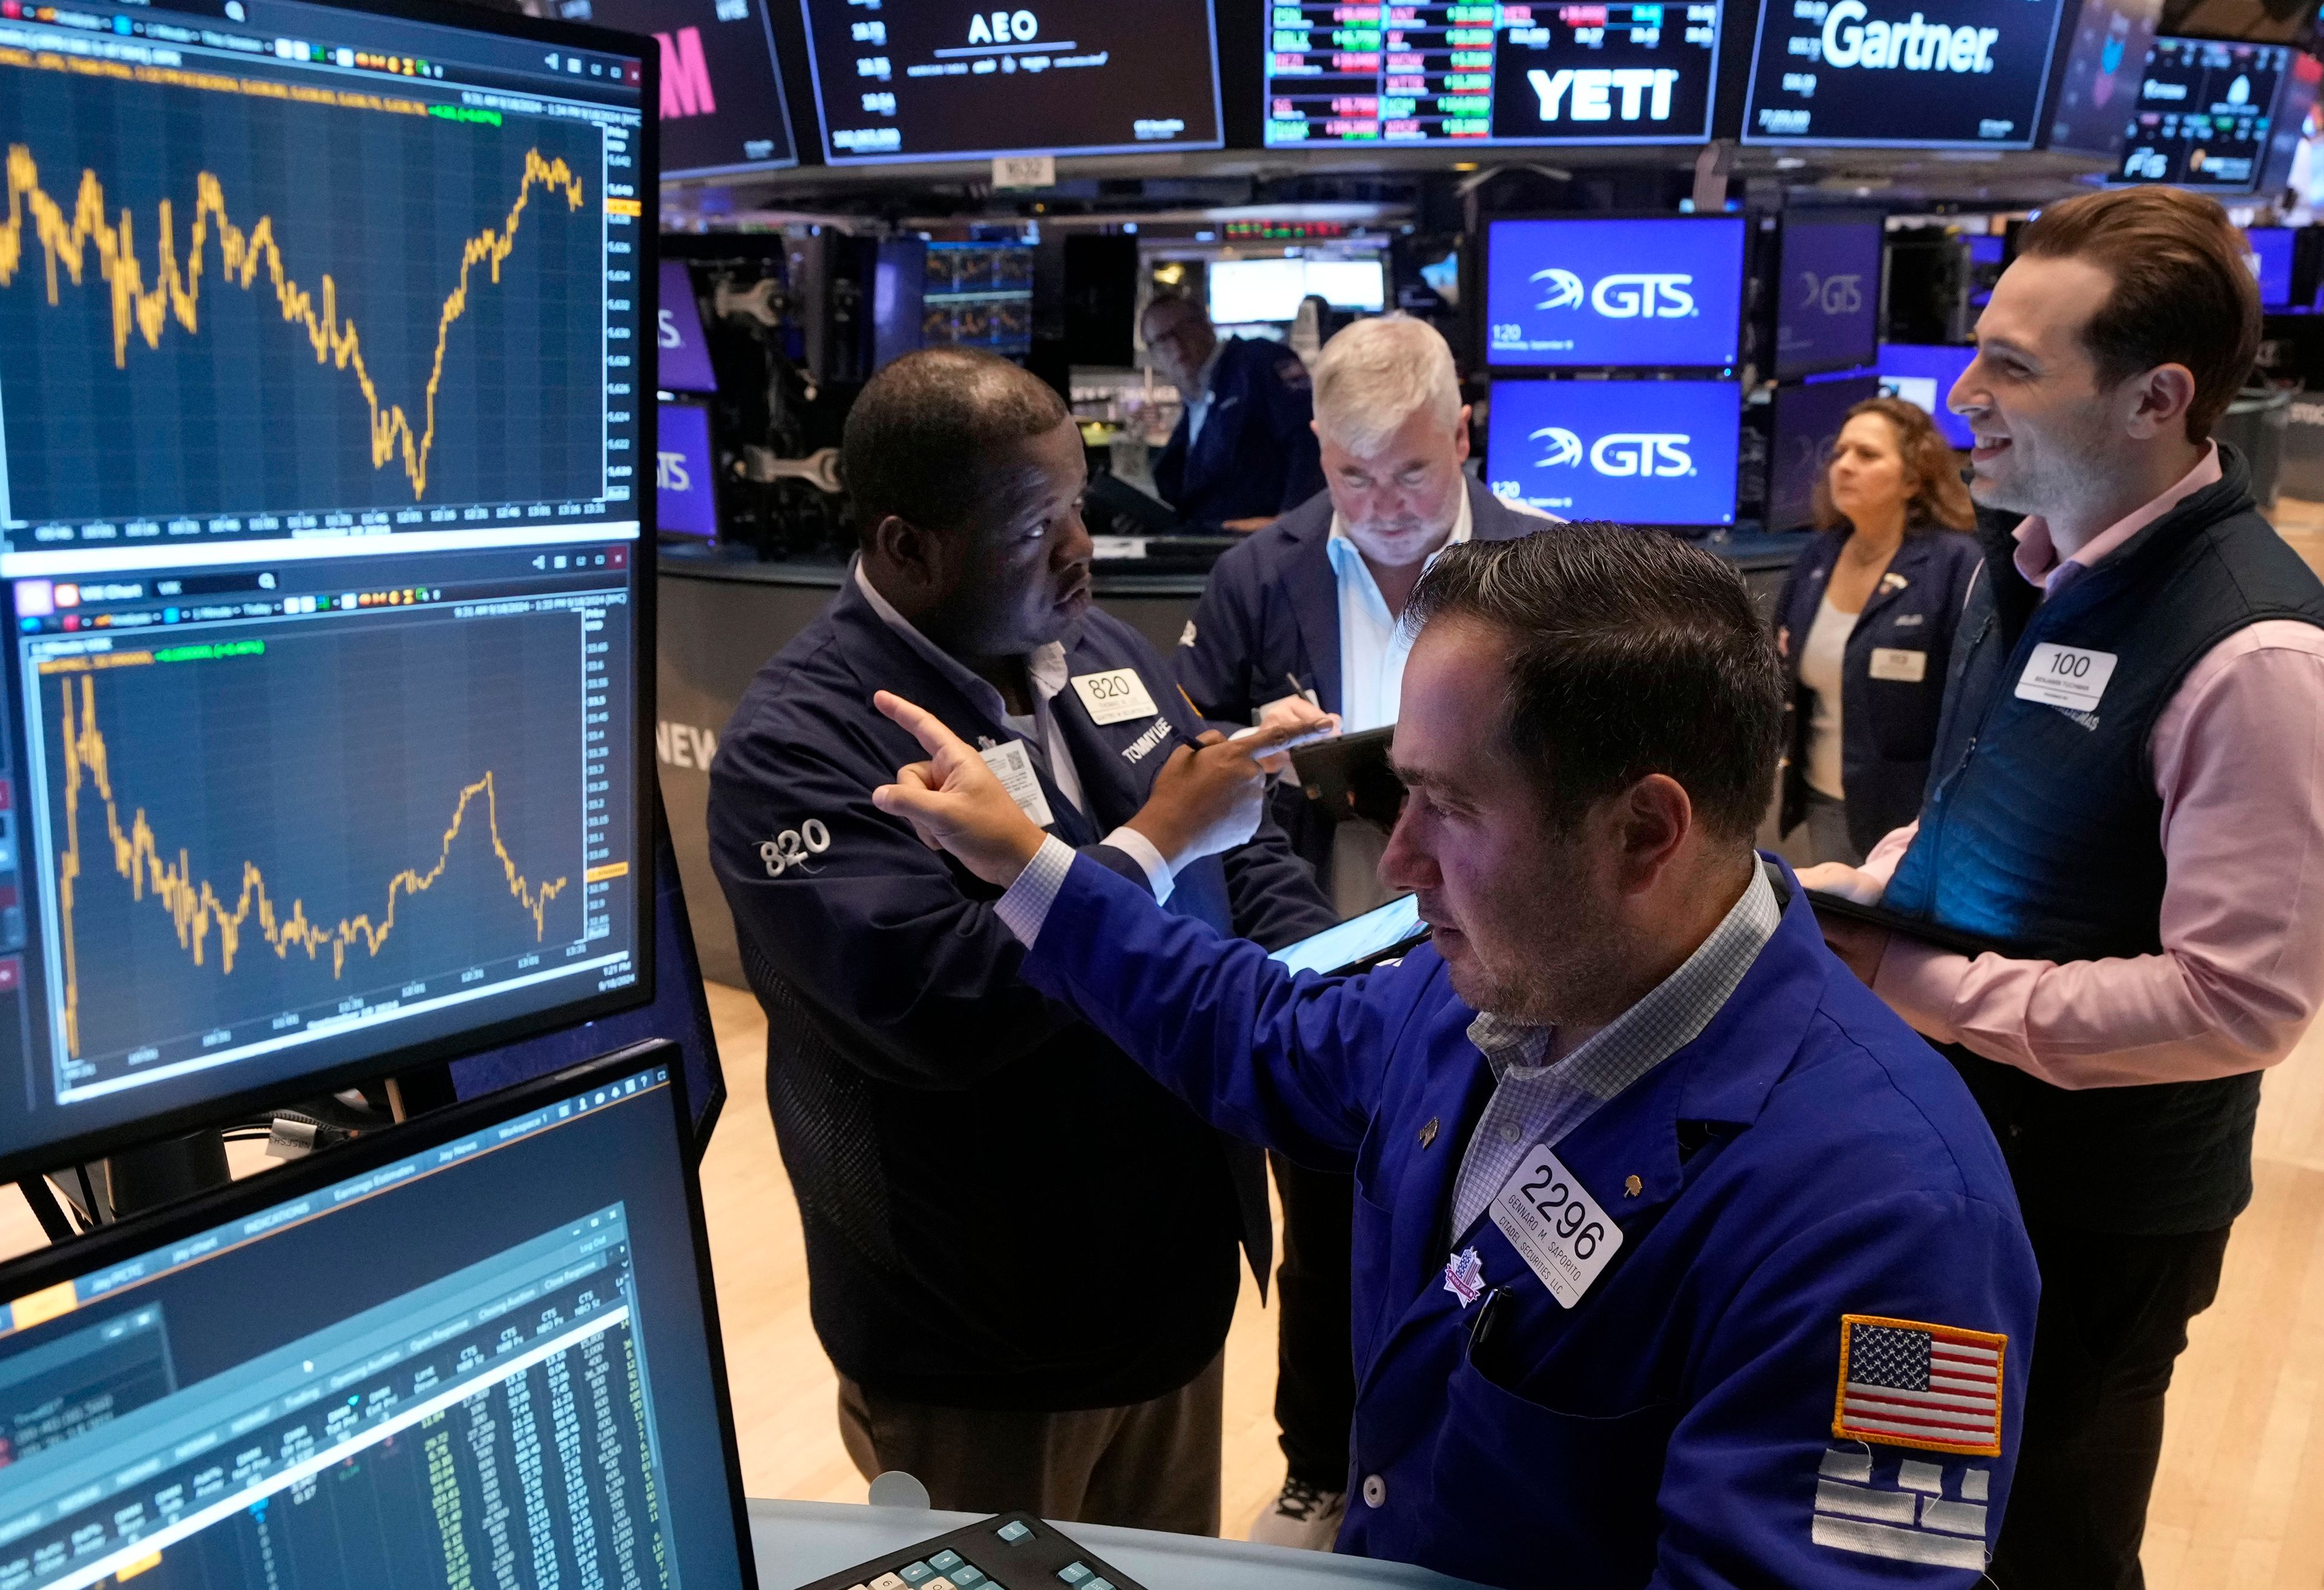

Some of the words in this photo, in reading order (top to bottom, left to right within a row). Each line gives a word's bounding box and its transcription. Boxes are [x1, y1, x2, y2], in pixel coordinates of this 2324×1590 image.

[968, 10, 1039, 44] AEO
[1822, 0, 1998, 73] Gartner
[1527, 69, 1673, 121] YETI
[1591, 274, 1694, 318] GTS
[1590, 433, 1692, 477] GTS
[2051, 652, 2090, 677] 100
[1089, 676, 1130, 699] 820
[1121, 726, 1160, 764] TOMMY
[1152, 717, 1172, 739] LEE
[760, 818, 830, 877] 820
[1521, 1165, 1604, 1260] 2296
[1498, 1216, 1521, 1244] CITADEL
[1520, 1242, 1551, 1280] SECURITIES
[1550, 1278, 1563, 1295] LLC
[1508, 1195, 1539, 1231] GENNARO
[1548, 1241, 1581, 1281] SAPORITO
[1007, 1526, 1020, 1536] DONE
[1068, 1567, 1082, 1577] CLEAR
